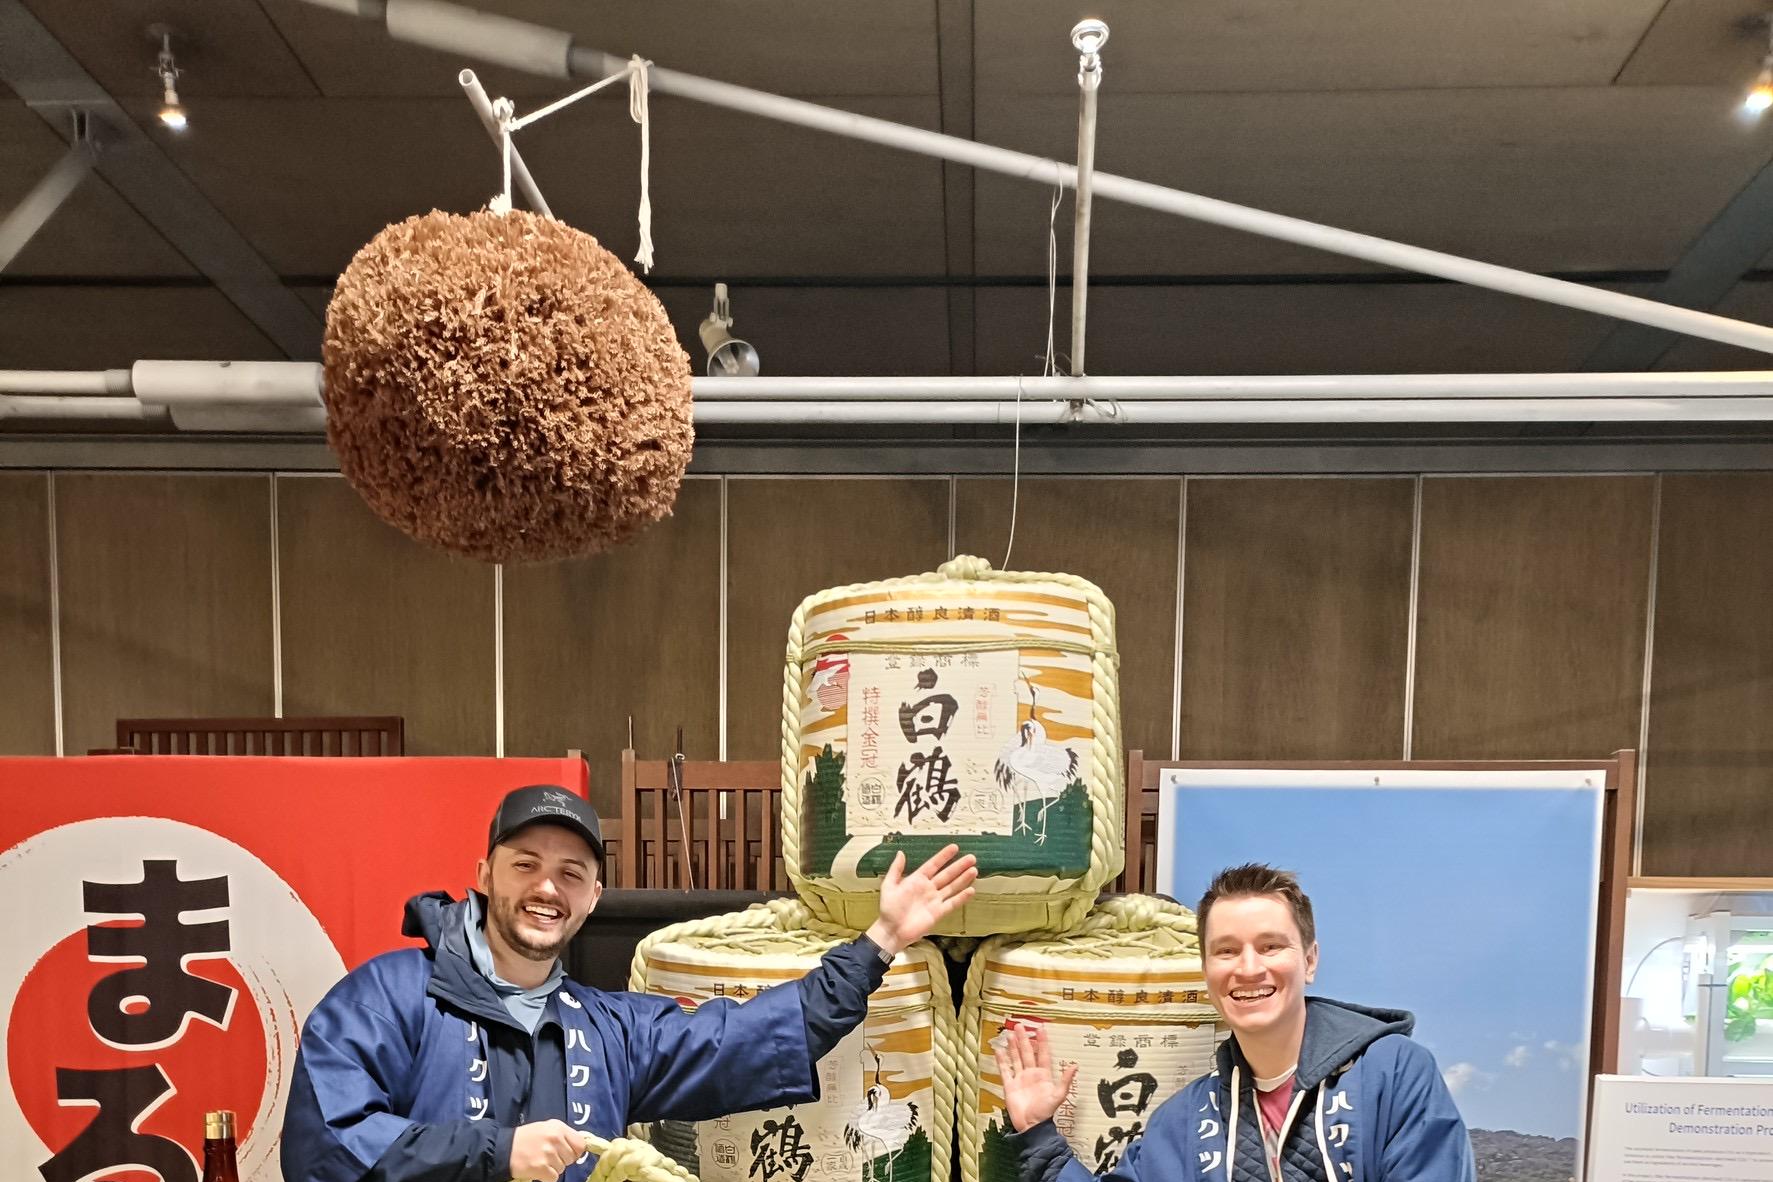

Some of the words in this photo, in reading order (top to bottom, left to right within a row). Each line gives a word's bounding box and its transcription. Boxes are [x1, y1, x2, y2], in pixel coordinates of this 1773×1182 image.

[894, 668, 961, 825] 白鶴
[568, 1029, 591, 1164] ハクツ
[1625, 1102, 1680, 1115] Utilization
[1684, 1104, 1695, 1115] of
[1669, 1122, 1753, 1135] Demonstration
